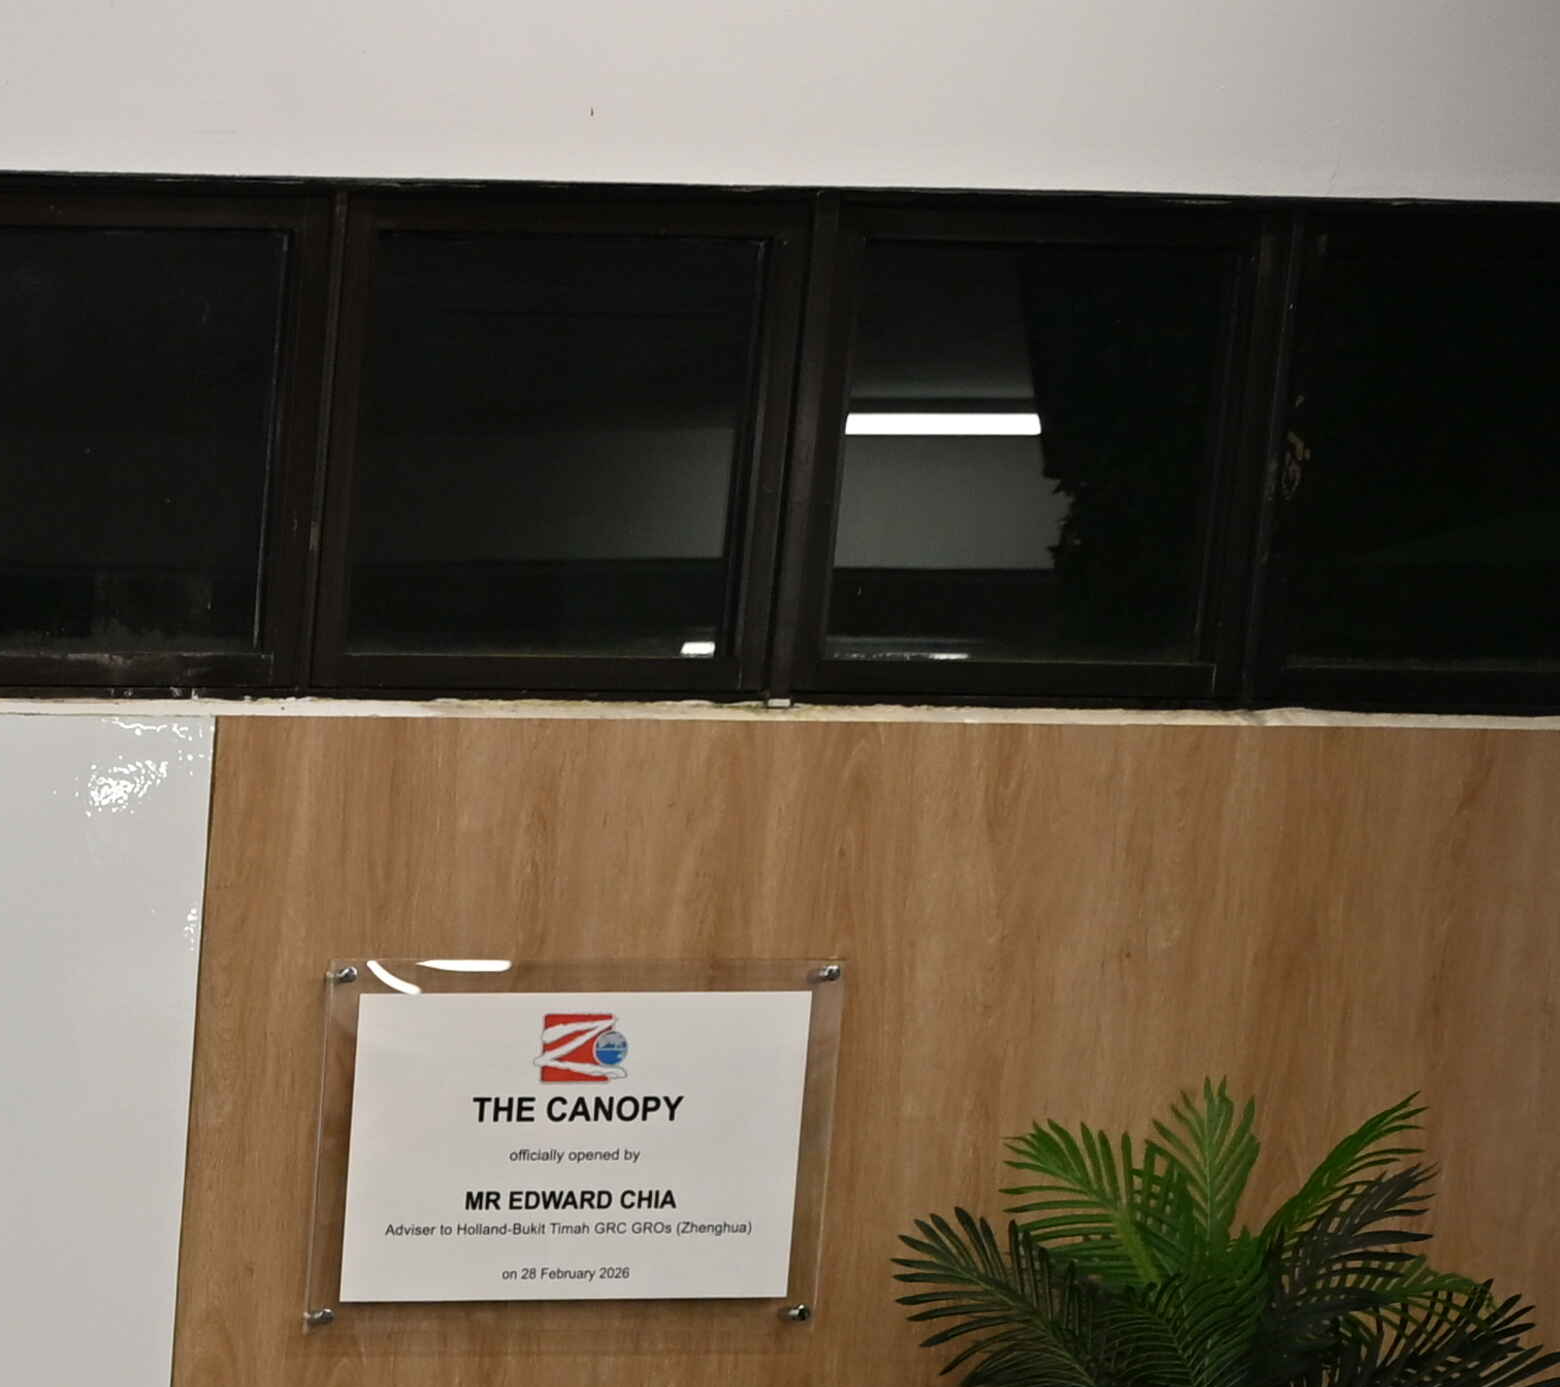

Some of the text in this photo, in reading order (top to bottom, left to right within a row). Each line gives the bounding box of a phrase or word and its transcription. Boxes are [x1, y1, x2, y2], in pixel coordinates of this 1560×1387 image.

[472, 1095, 684, 1123] THE CANOPY
[508, 1148, 641, 1164] officially opened by
[464, 1189, 677, 1211] MR EDWARD CHIA
[384, 1220, 753, 1237] Adviser to Holland-Bukit Timah GRC GROs (Zhenghua)
[501, 1266, 630, 1282] on 28 February 2026
